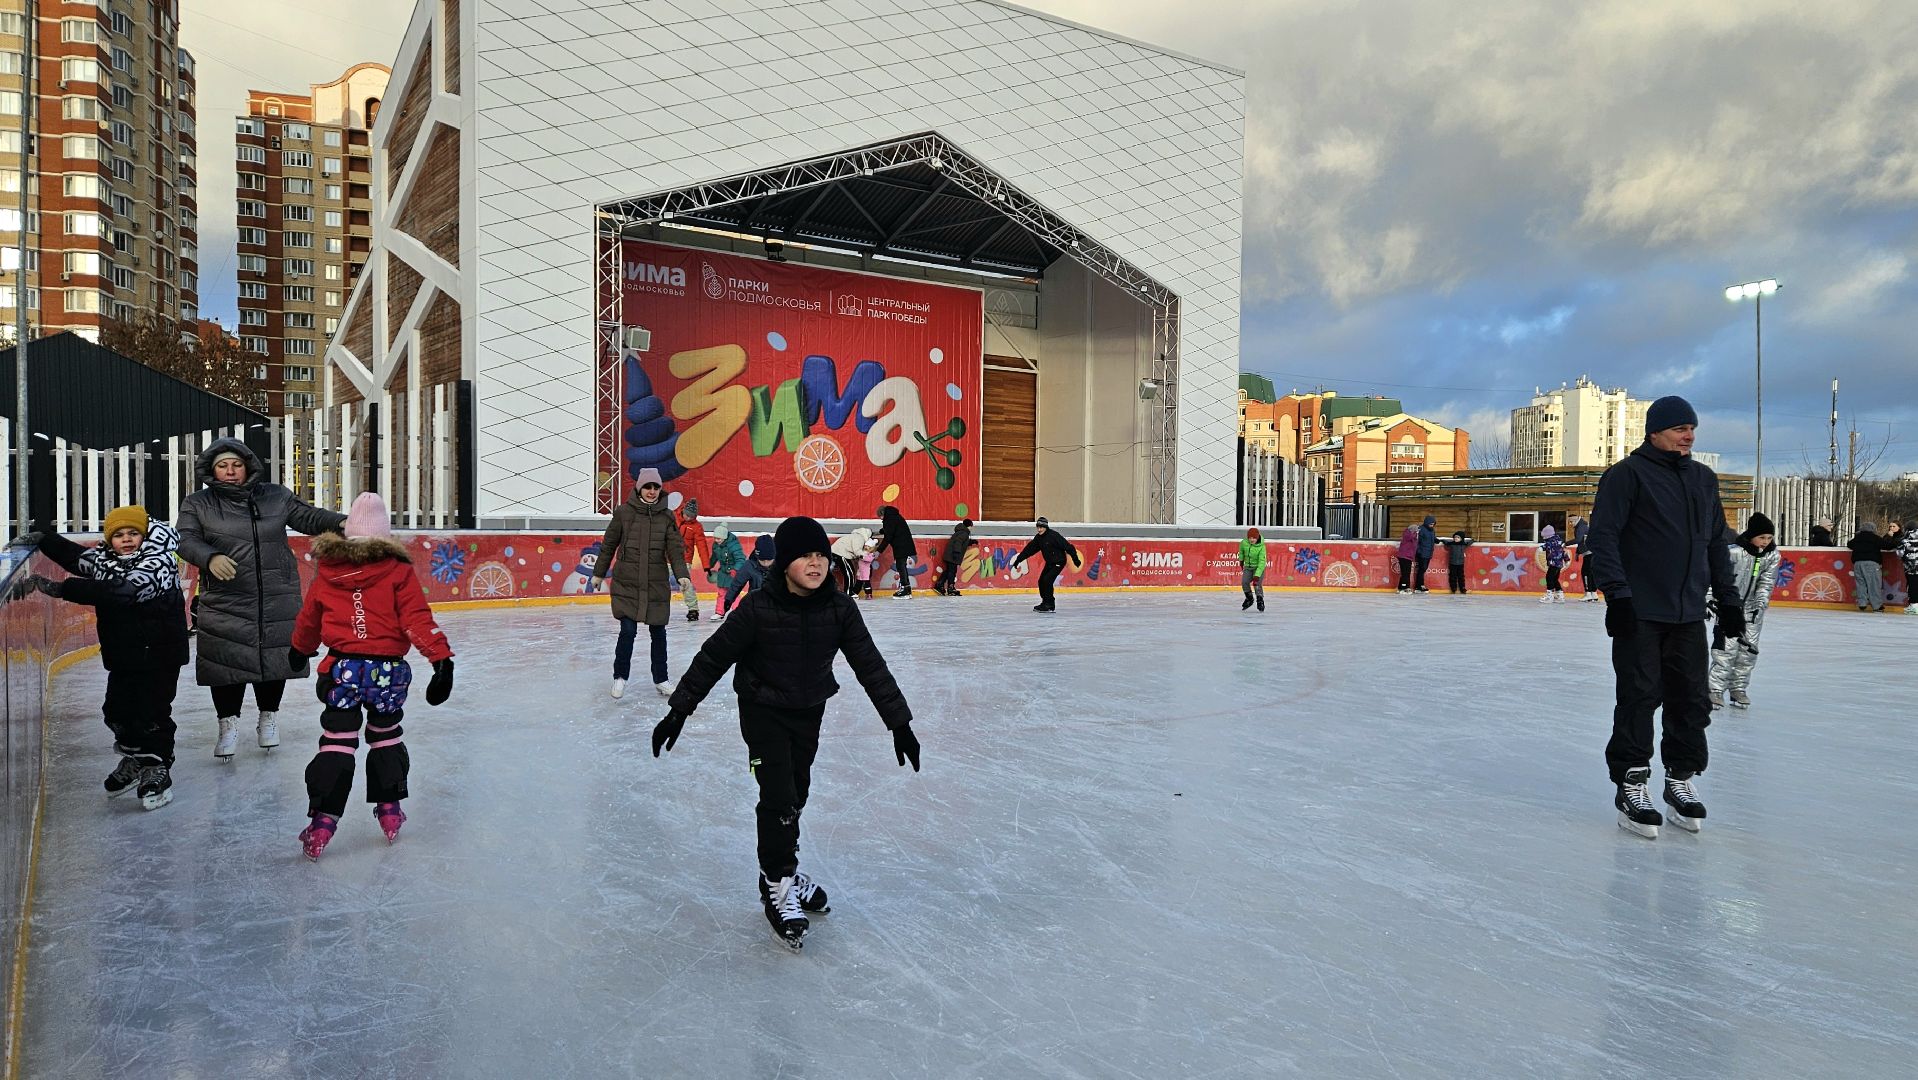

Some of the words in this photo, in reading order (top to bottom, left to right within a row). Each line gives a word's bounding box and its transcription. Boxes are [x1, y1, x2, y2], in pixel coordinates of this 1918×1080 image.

[728, 277, 769, 292] ПАРКИ
[728, 290, 822, 311] ПОДМОСКОВЬЯ
[867, 296, 931, 313] ЦЕНТРАЛЬНЫЙ
[867, 309, 891, 320] ПАРК
[891, 312, 928, 325] ПОБЕДЫ
